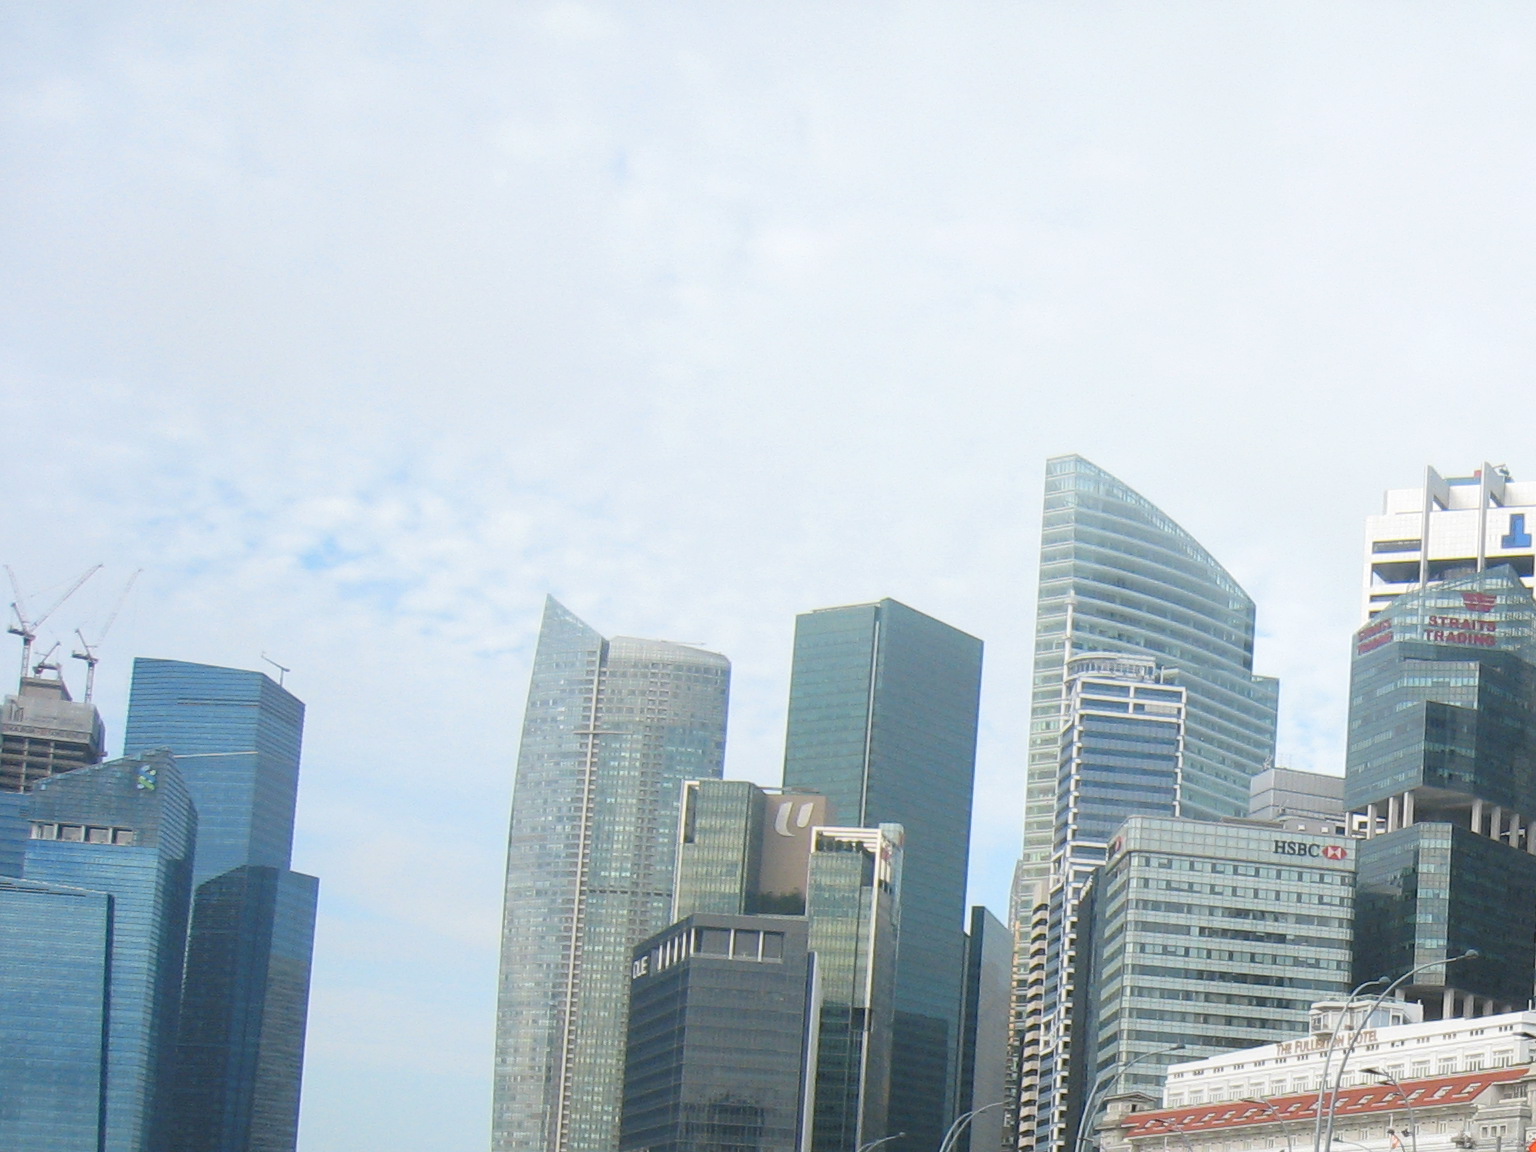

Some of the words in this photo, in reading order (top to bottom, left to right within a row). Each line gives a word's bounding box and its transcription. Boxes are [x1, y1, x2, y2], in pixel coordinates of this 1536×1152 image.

[1428, 615, 1496, 632] STRAITS
[1424, 629, 1497, 646] TRADING
[1273, 840, 1320, 857] HSBC
[1276, 1042, 1292, 1056] THE
